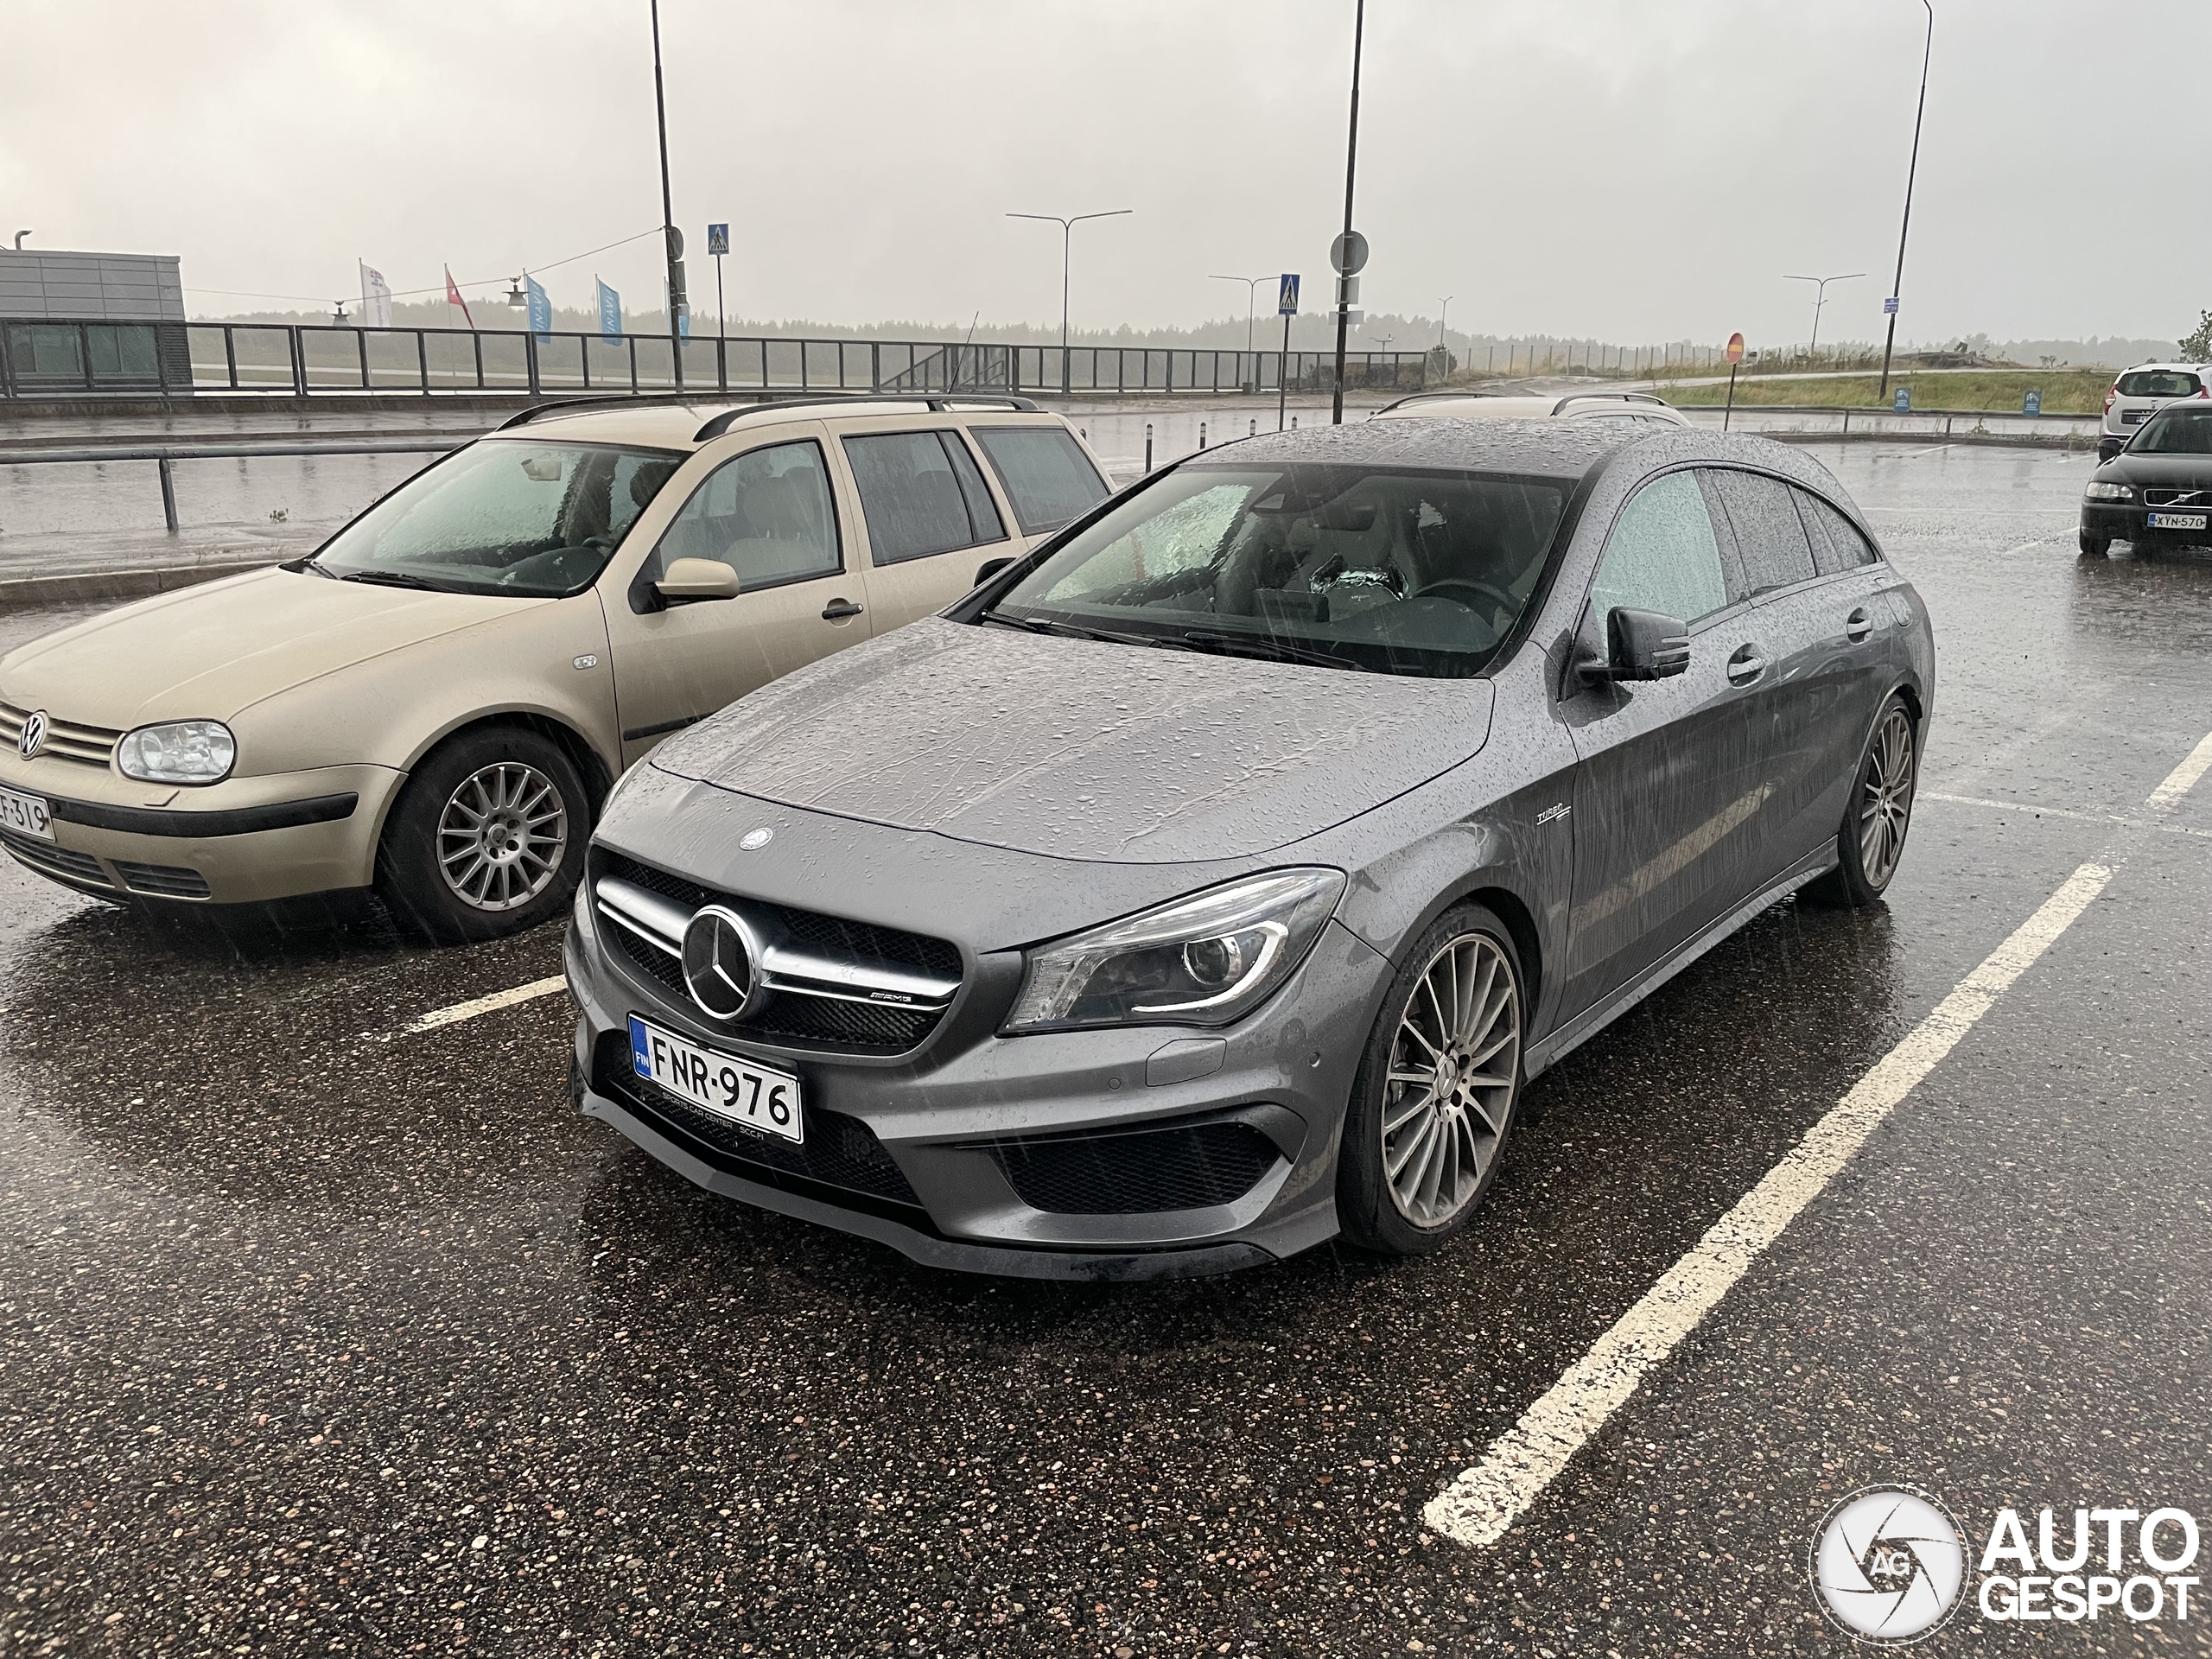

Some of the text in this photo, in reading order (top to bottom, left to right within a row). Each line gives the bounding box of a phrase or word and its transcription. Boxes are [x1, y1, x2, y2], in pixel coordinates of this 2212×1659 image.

[2157, 516, 2202, 527] XYN-570
[635, 1051, 650, 1068] FIN
[652, 1034, 791, 1126] FNR-976
[662, 1091, 689, 1110] SPORTS
[690, 1105, 704, 1117] CAR
[704, 1113, 733, 1128] CENTER
